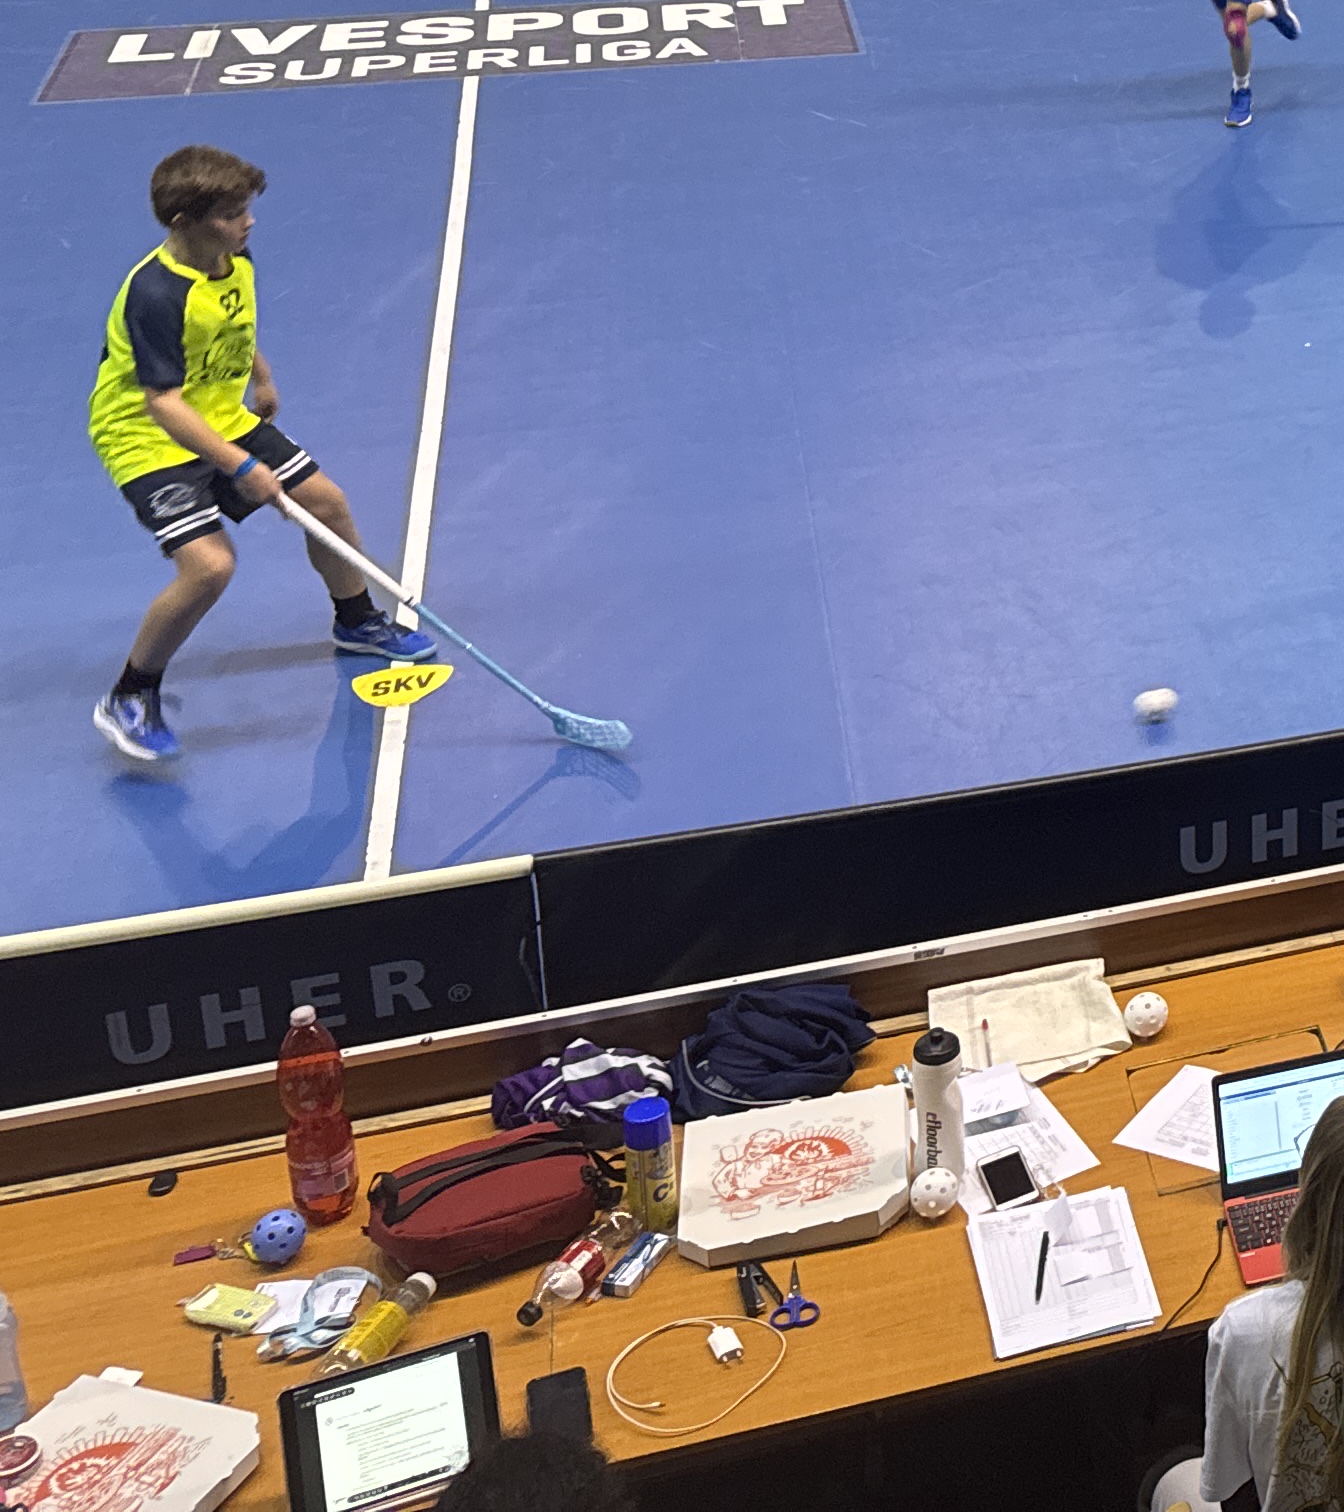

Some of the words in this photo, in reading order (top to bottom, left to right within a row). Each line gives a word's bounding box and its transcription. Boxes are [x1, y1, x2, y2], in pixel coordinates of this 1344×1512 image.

[218, 37, 708, 86] SUPERLIGA
[372, 671, 437, 698] SKV
[105, 958, 432, 1066] UHER
[926, 1112, 943, 1170] efloorba
